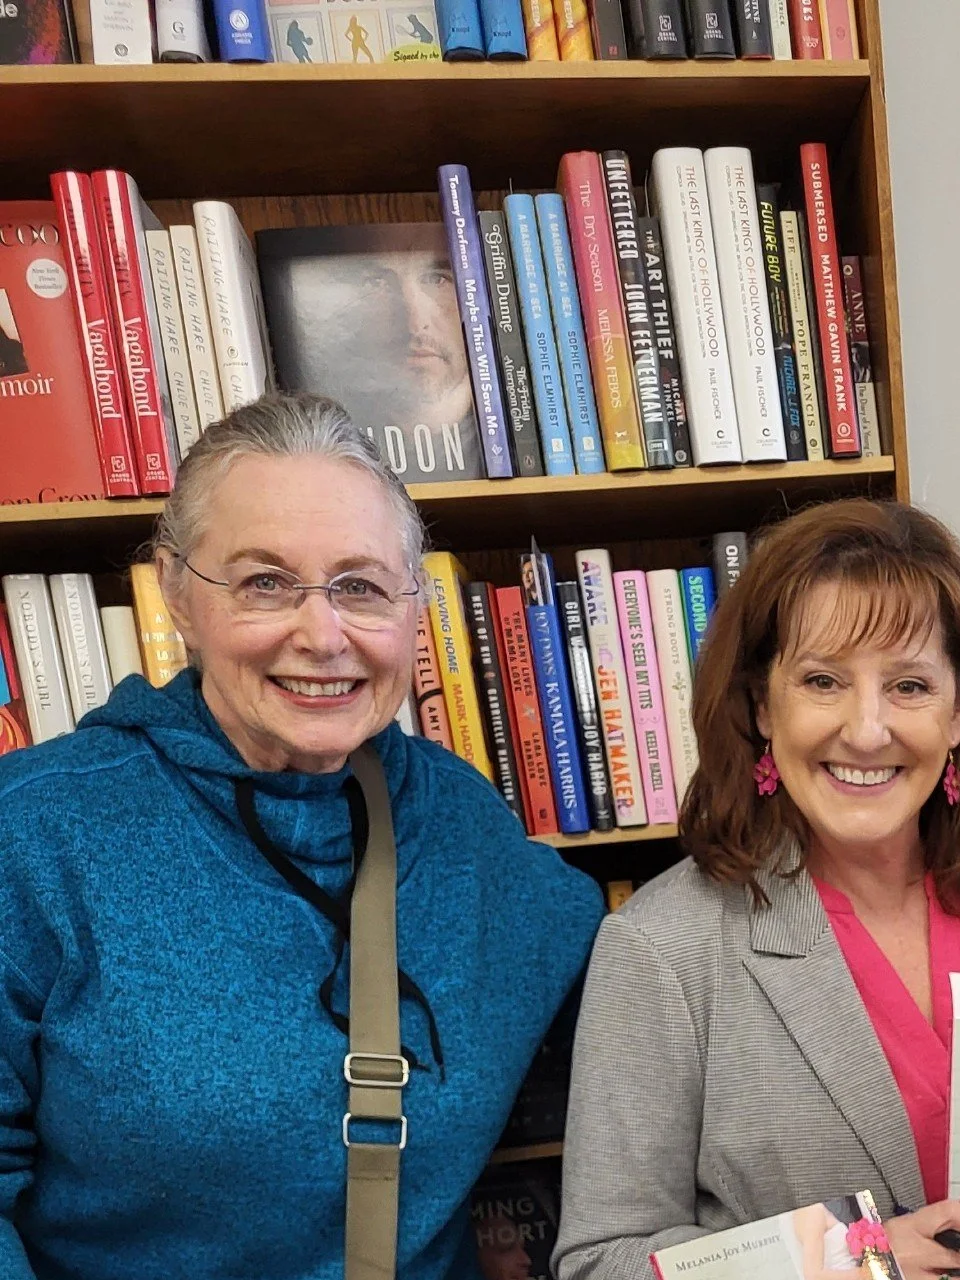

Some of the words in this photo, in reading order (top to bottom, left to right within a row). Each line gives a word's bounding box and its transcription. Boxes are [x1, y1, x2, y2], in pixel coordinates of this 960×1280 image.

[393, 50, 419, 62] Signed
[448, 175, 461, 216] Tommy
[578, 181, 593, 207] The
[685, 166, 696, 188] THE
[734, 166, 745, 187] THE
[605, 159, 639, 259] UNFETTERED
[688, 190, 701, 216] LAST
[736, 190, 749, 216] LAST
[810, 163, 830, 242] SUBMERSED
[454, 218, 471, 269] Dorfman
[582, 215, 596, 242] Dry
[645, 230, 655, 250] THE
[693, 220, 706, 253] KINGS
[740, 219, 753, 252] KINGS
[760, 201, 778, 252] FUTURE
[784, 219, 796, 254] LIFE
[485, 224, 506, 280] Griffin
[519, 223, 536, 277] MARRIAGE
[548, 222, 567, 277] MARRIAGE
[588, 244, 605, 292] Season
[698, 257, 709, 276] OF
[745, 256, 755, 275] OF
[766, 254, 782, 282] BOY
[202, 215, 225, 286] RAISING
[216, 292, 233, 337] HARE
[645, 252, 665, 293] ART
[821, 254, 836, 318] MATTHEW
[464, 279, 483, 322] Maybe
[495, 283, 513, 333] Dunne
[530, 299, 542, 319] SEA
[560, 297, 573, 318] SEA
[624, 283, 647, 324] JOHN
[699, 277, 719, 358] HOLLYWOOD
[747, 276, 767, 356] HOLLYWOOD
[851, 289, 867, 333] ANNE
[153, 248, 172, 309] RAISING
[165, 316, 179, 355] HARE
[173, 371, 188, 408] CHLOE
[178, 246, 199, 307] RAISING
[191, 314, 206, 353] HARE
[199, 370, 214, 407] CHLOE
[472, 325, 487, 352] This
[597, 309, 614, 362] MELISSA
[651, 299, 674, 360] THIEF
[796, 319, 808, 357] POPE
[827, 323, 841, 363] GAVIN
[87, 318, 121, 418] Vagabond
[124, 316, 157, 417] Vagabond
[477, 354, 491, 381] Will
[536, 332, 551, 371] SOPHIE
[567, 331, 582, 369] SOPHIE
[607, 366, 622, 408] FEBOS
[632, 329, 662, 423] FETTERMAN
[708, 367, 717, 385] PAUL
[755, 365, 763, 384] PAUL
[783, 355, 797, 395] MICHAEL
[833, 368, 847, 411] FRANK
[481, 383, 495, 413] Save
[543, 374, 559, 427] ELMHIRST
[574, 373, 590, 426] ELMHIRST
[662, 383, 675, 423] FINKEL
[671, 378, 685, 427] MICHAEL
[710, 387, 721, 420] FISCHER
[757, 385, 768, 418] FISCHER
[801, 364, 816, 427] FRANCIS
[485, 415, 498, 435] Me
[789, 408, 801, 428] FOX
[725, 545, 740, 567] ON
[433, 578, 454, 633] LEAVING
[471, 596, 484, 622] NEXT
[581, 561, 608, 626] AWAKE
[623, 579, 644, 640] EVERYONE'S
[663, 588, 676, 628] STRONG
[688, 575, 708, 633] SECOND
[477, 628, 488, 640] OF
[512, 611, 521, 630] THE
[534, 611, 551, 634] 107
[564, 601, 581, 631] GIRL
[18, 590, 42, 669] NOBODY'S
[35, 674, 51, 711] GIRL
[417, 646, 435, 688] TELL
[443, 636, 459, 674] HOME
[480, 647, 492, 664] KIN
[504, 628, 517, 663] MAMA
[511, 666, 521, 692] LOVE
[516, 634, 528, 665] MANY
[537, 635, 556, 676] DAYS
[632, 642, 647, 667] SEEN
[669, 632, 681, 665] ROOTS
[521, 667, 533, 696] LIVES
[597, 664, 619, 701] JEN
[635, 670, 647, 686] MY
[428, 706, 441, 731] AMY
[451, 683, 468, 722] MARK
[487, 688, 505, 744] GABRIELLE
[546, 682, 566, 749] KAMALA
[640, 690, 653, 709] TITS
[678, 708, 690, 731] OLIA
[583, 724, 600, 749] JOY
[645, 730, 659, 760] KEELEY
[498, 749, 514, 801] HAMILTON
[590, 753, 606, 795] HARJO
[604, 709, 635, 809] HATMAKER
[649, 762, 664, 792] HAZELL
[560, 752, 577, 809] HARRIS
[675, 1252, 722, 1273] MELANIA
[722, 1246, 740, 1264] JOY
[741, 1233, 782, 1252] MURPHY
